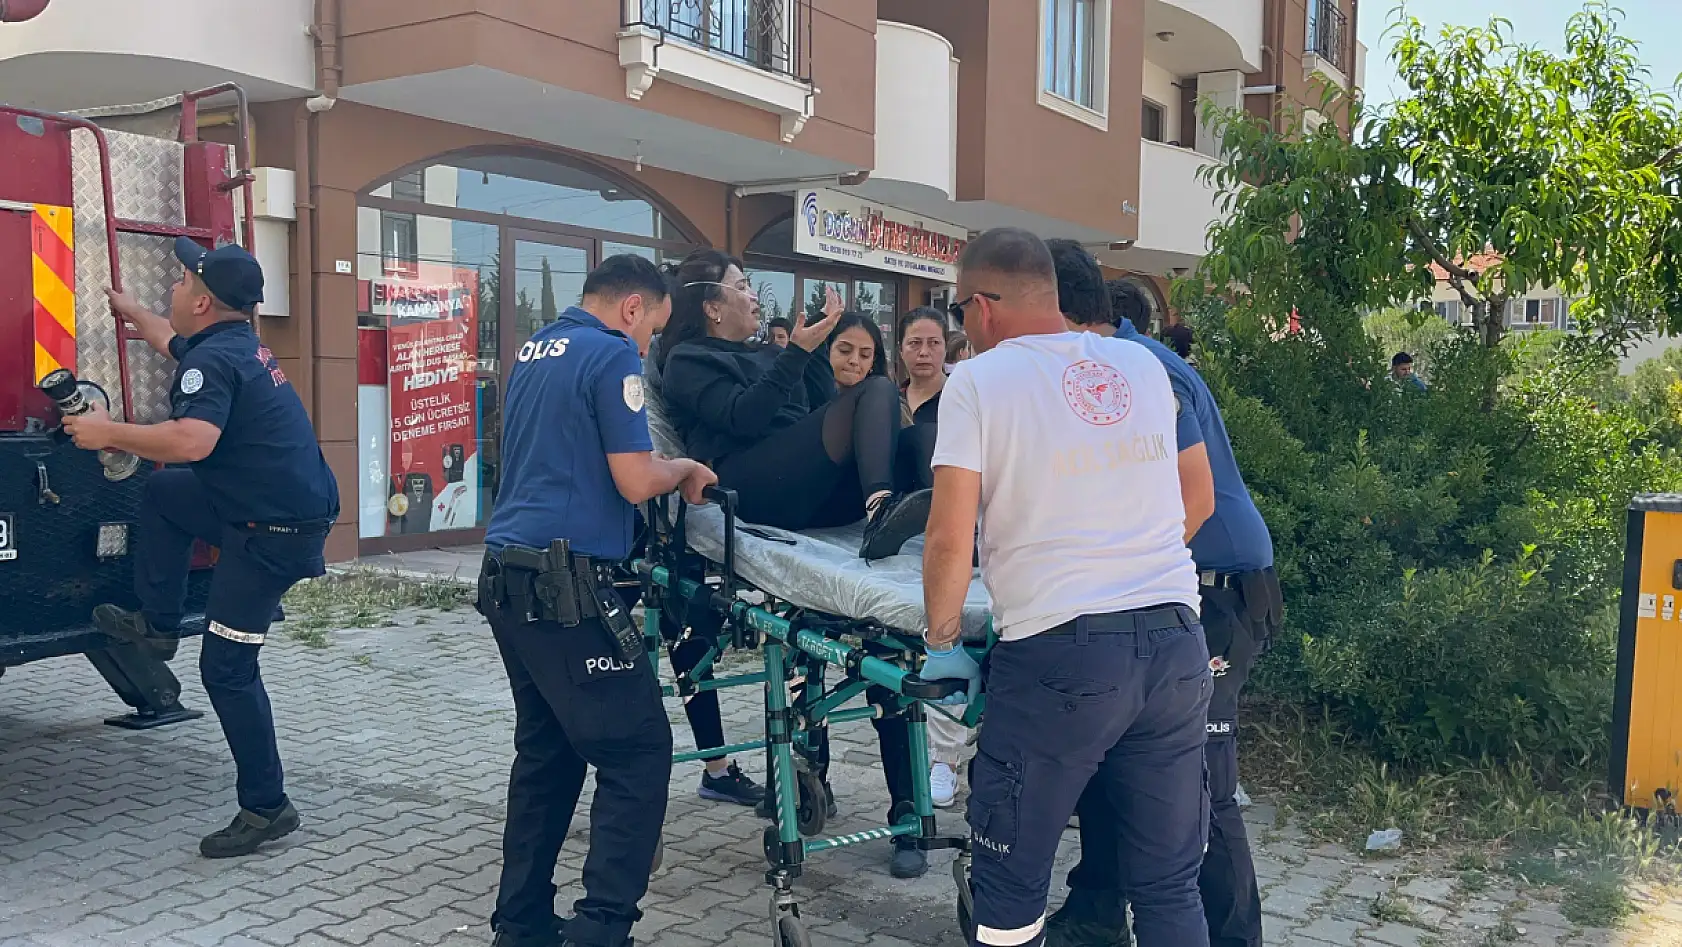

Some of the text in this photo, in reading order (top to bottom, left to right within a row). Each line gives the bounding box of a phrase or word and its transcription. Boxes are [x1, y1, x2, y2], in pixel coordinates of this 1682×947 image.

[397, 298, 463, 318] KAMPANYA
[422, 342, 460, 357] HERKESE
[403, 366, 459, 392] HEDİYE
[410, 392, 451, 411] ÜSTELİK
[427, 400, 471, 421] ÜCRETSİZ
[393, 415, 470, 442] DENEME FIRSATI
